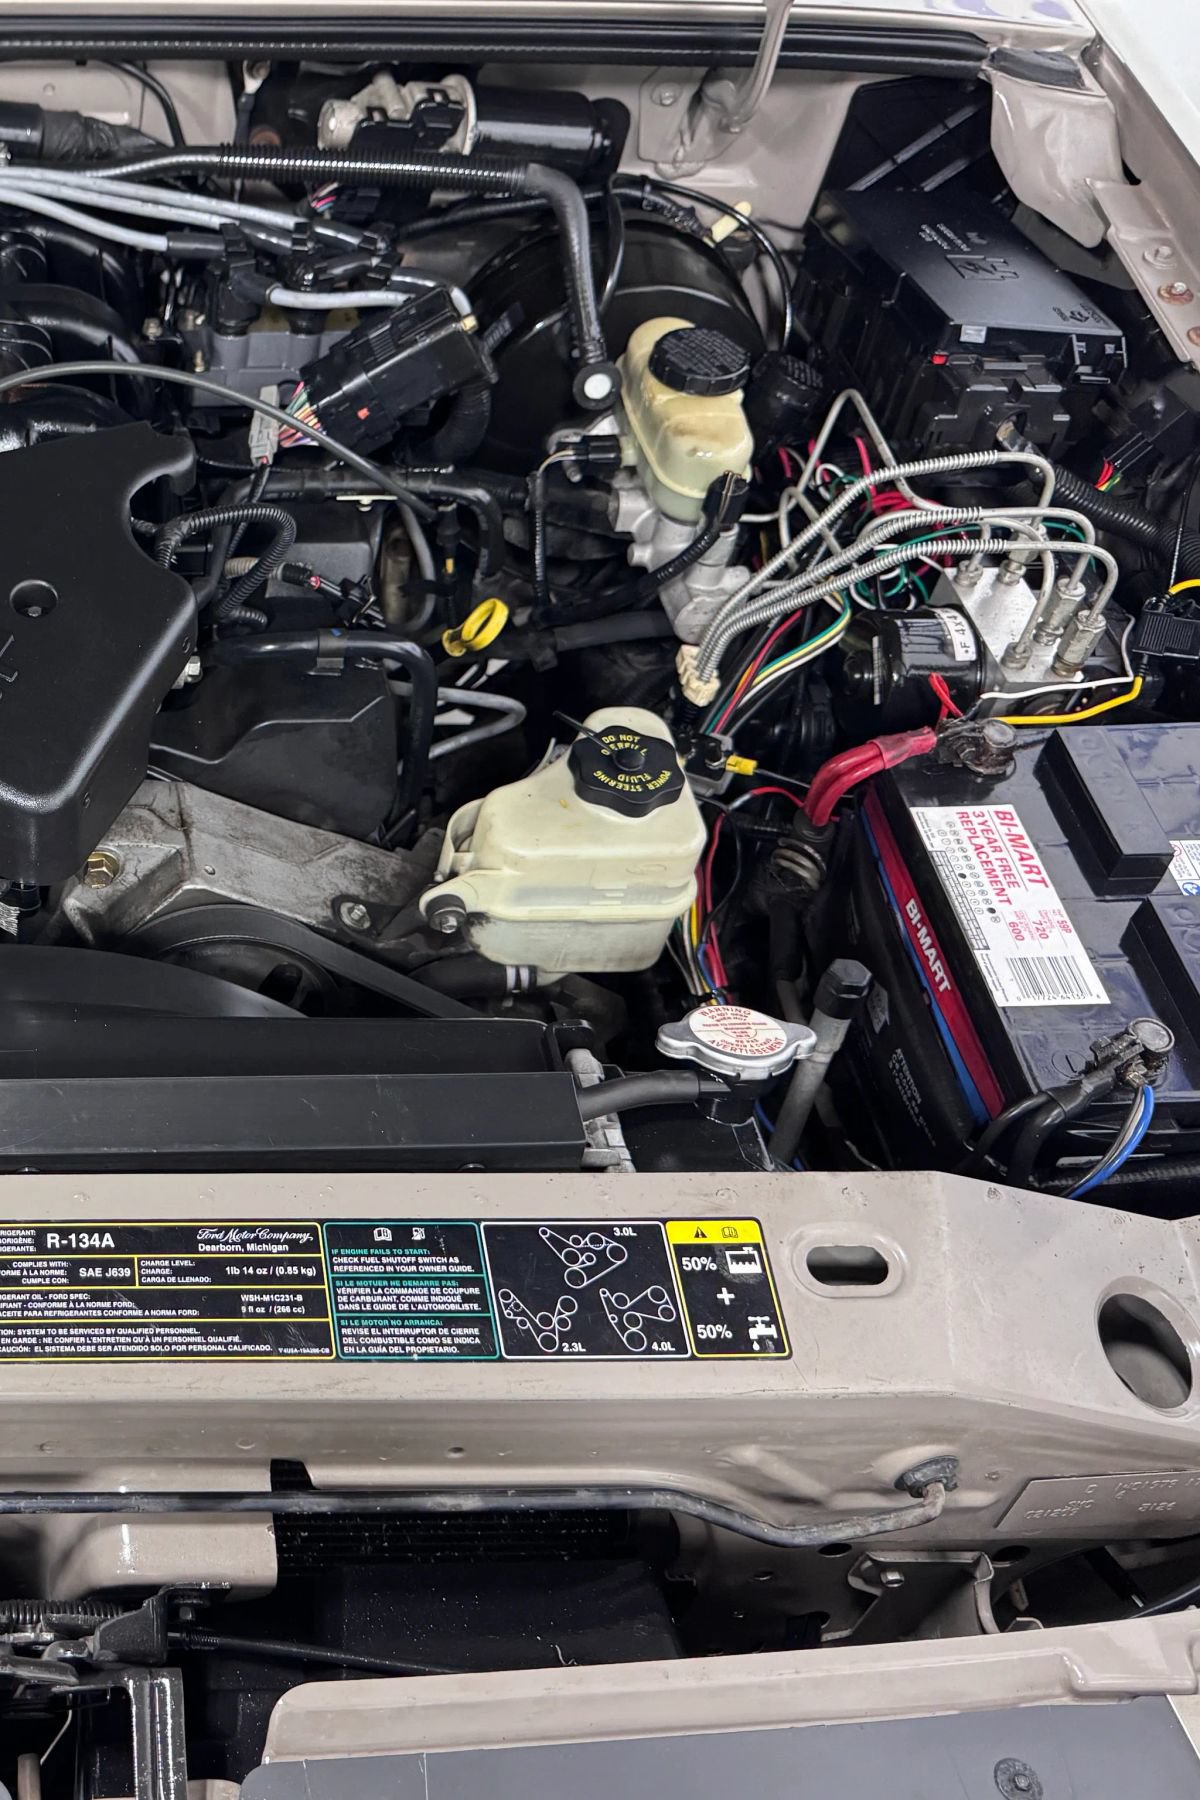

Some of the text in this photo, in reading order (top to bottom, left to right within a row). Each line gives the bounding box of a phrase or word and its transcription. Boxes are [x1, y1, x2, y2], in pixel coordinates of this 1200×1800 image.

[602, 734, 640, 744] DO NOT
[593, 770, 672, 792] POWER STEERING
[617, 773, 652, 784] FLUID
[978, 820, 1003, 854] YEAR
[994, 857, 1021, 889] FREE
[994, 810, 1050, 888] BI-MART
[956, 811, 1013, 906] REPLACEMENT
[1008, 922, 1025, 942] 600
[1032, 920, 1049, 940] 720
[698, 1006, 752, 1016] WARNING
[708, 1037, 785, 1055] AVERTISSEMENT
[197, 1228, 224, 1240] Ford
[223, 1228, 256, 1243] Motor
[613, 1226, 637, 1236] 3.0L
[47, 1233, 115, 1248] R-134A
[198, 1243, 288, 1253] Dearborn, Michigan
[243, 1267, 253, 1275] 14
[276, 1266, 298, 1276] (0.85
[301, 1266, 316, 1276] kg)
[682, 1257, 717, 1271] 50%
[79, 1267, 131, 1277] SAE J639
[241, 1294, 303, 1302] WSH-M1C231-B
[697, 1325, 732, 1339] 50%
[562, 1342, 586, 1352] 2.3L
[652, 1341, 675, 1351] 4.0L
